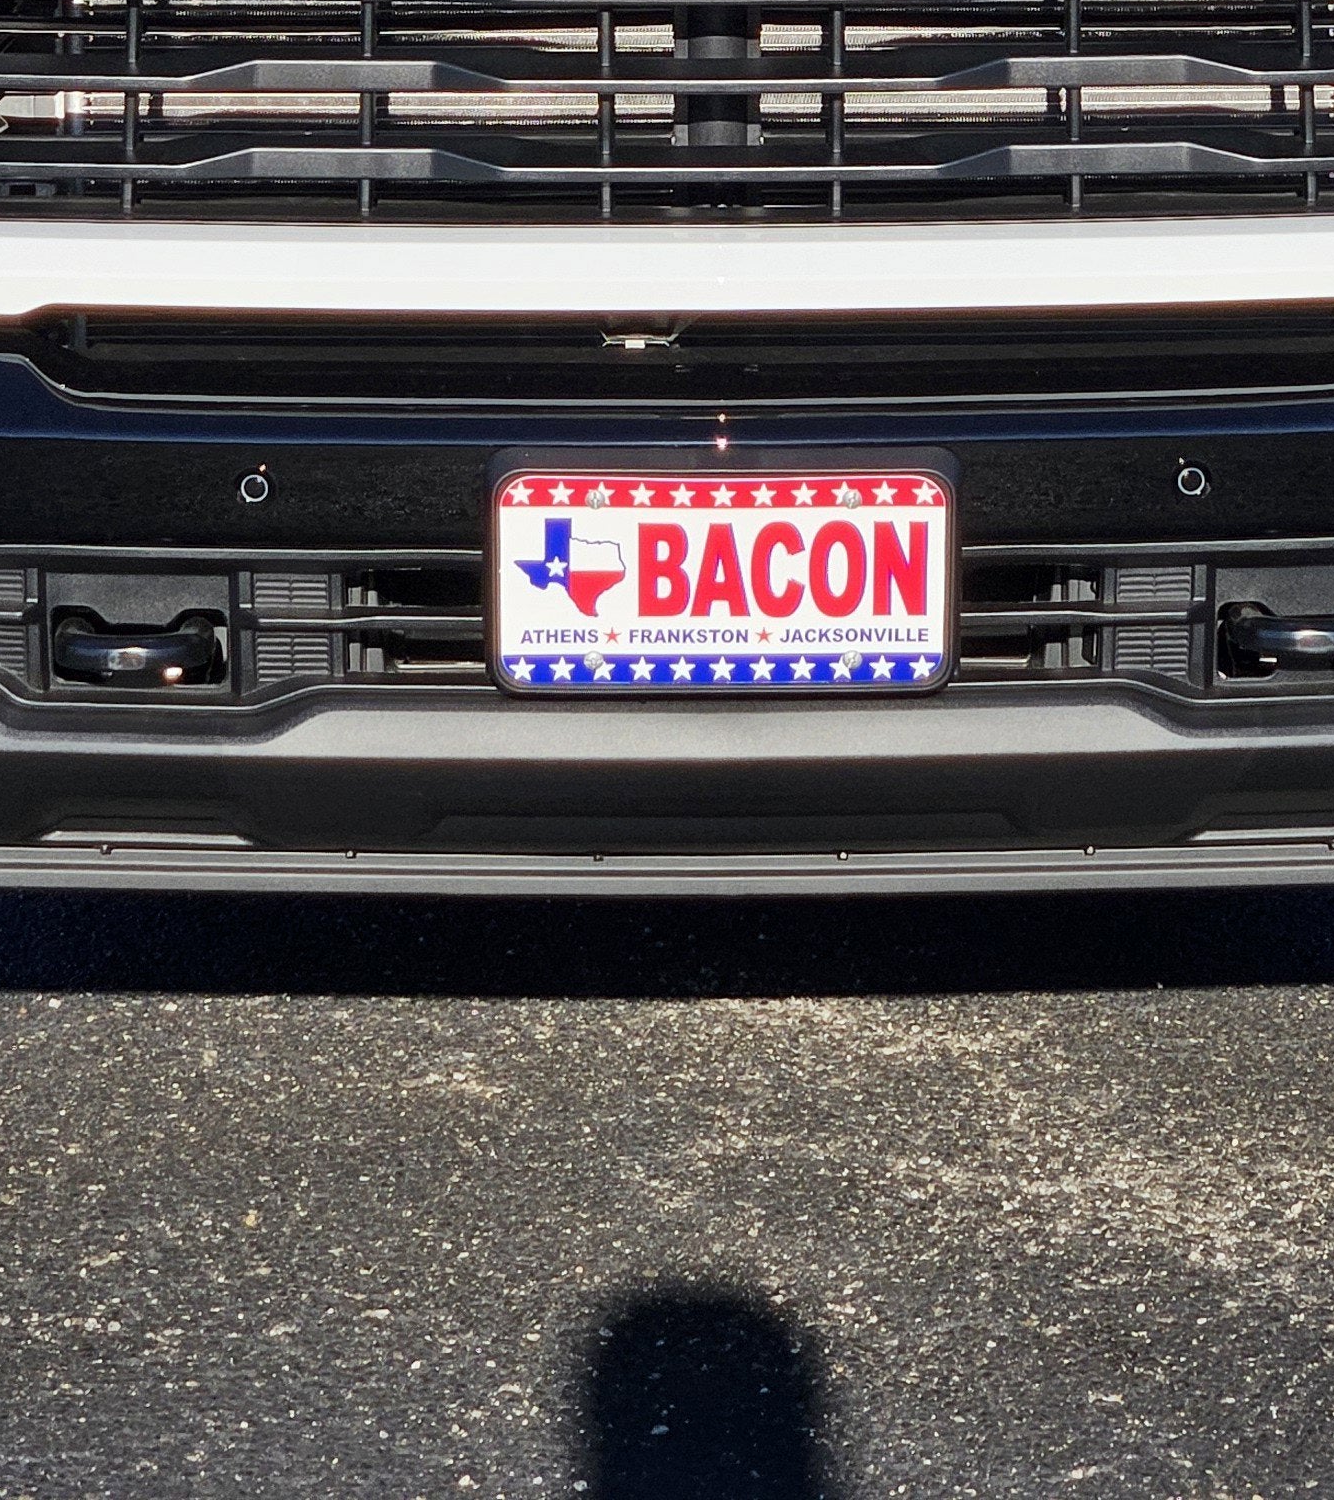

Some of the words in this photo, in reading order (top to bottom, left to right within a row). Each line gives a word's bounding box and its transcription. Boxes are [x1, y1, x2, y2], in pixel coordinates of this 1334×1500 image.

[637, 520, 928, 618] BACON
[520, 628, 599, 645] ATHENS
[628, 628, 750, 644] FRANKSTON
[779, 627, 930, 644] JACKSONVILLE
